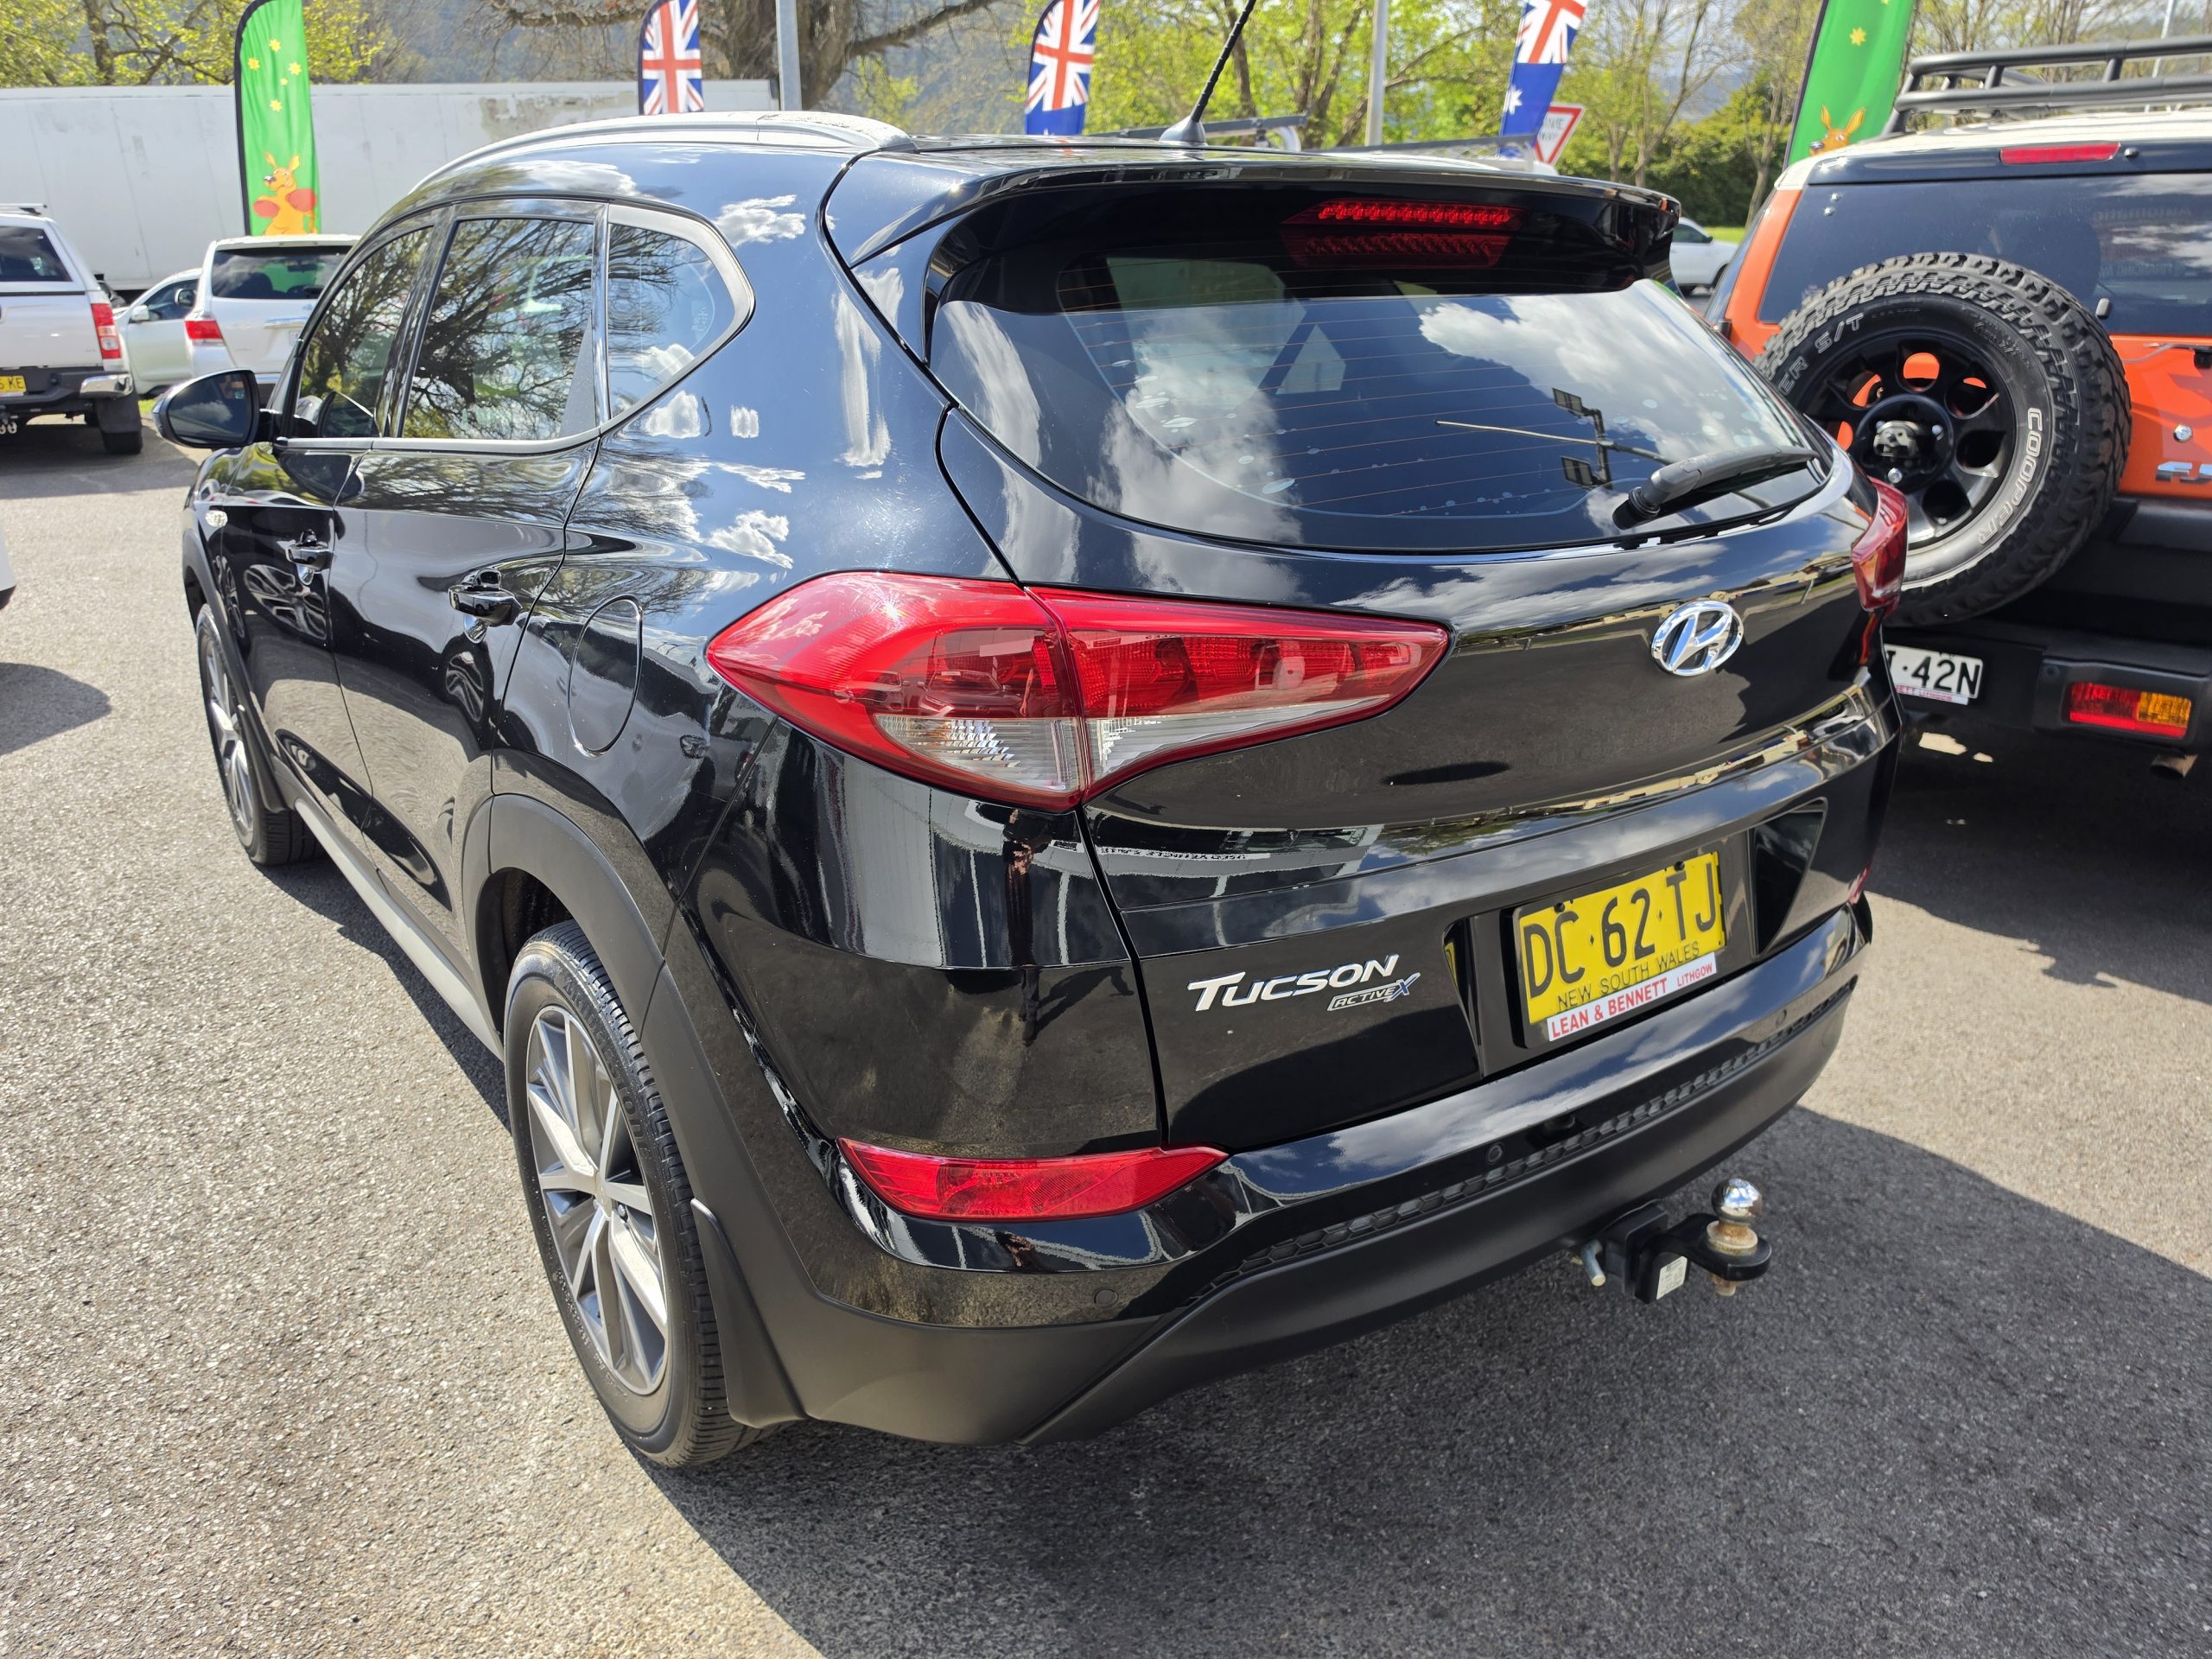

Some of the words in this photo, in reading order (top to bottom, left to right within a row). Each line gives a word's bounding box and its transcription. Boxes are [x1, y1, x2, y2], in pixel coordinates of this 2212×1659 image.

[1815, 312, 1864, 354] S/T
[1976, 407, 2043, 544] COOPER
[1187, 953, 1400, 1012] TUCSON
[1551, 1009, 1590, 1038] LEAN
[1594, 1004, 1605, 1021] &
[1607, 978, 1668, 1016] BENNETT
[1676, 963, 1713, 987] LITHGOW
[1557, 983, 1592, 1011] NEW
[1600, 963, 1649, 994] SOUTH
[1656, 941, 1700, 970] WALES
